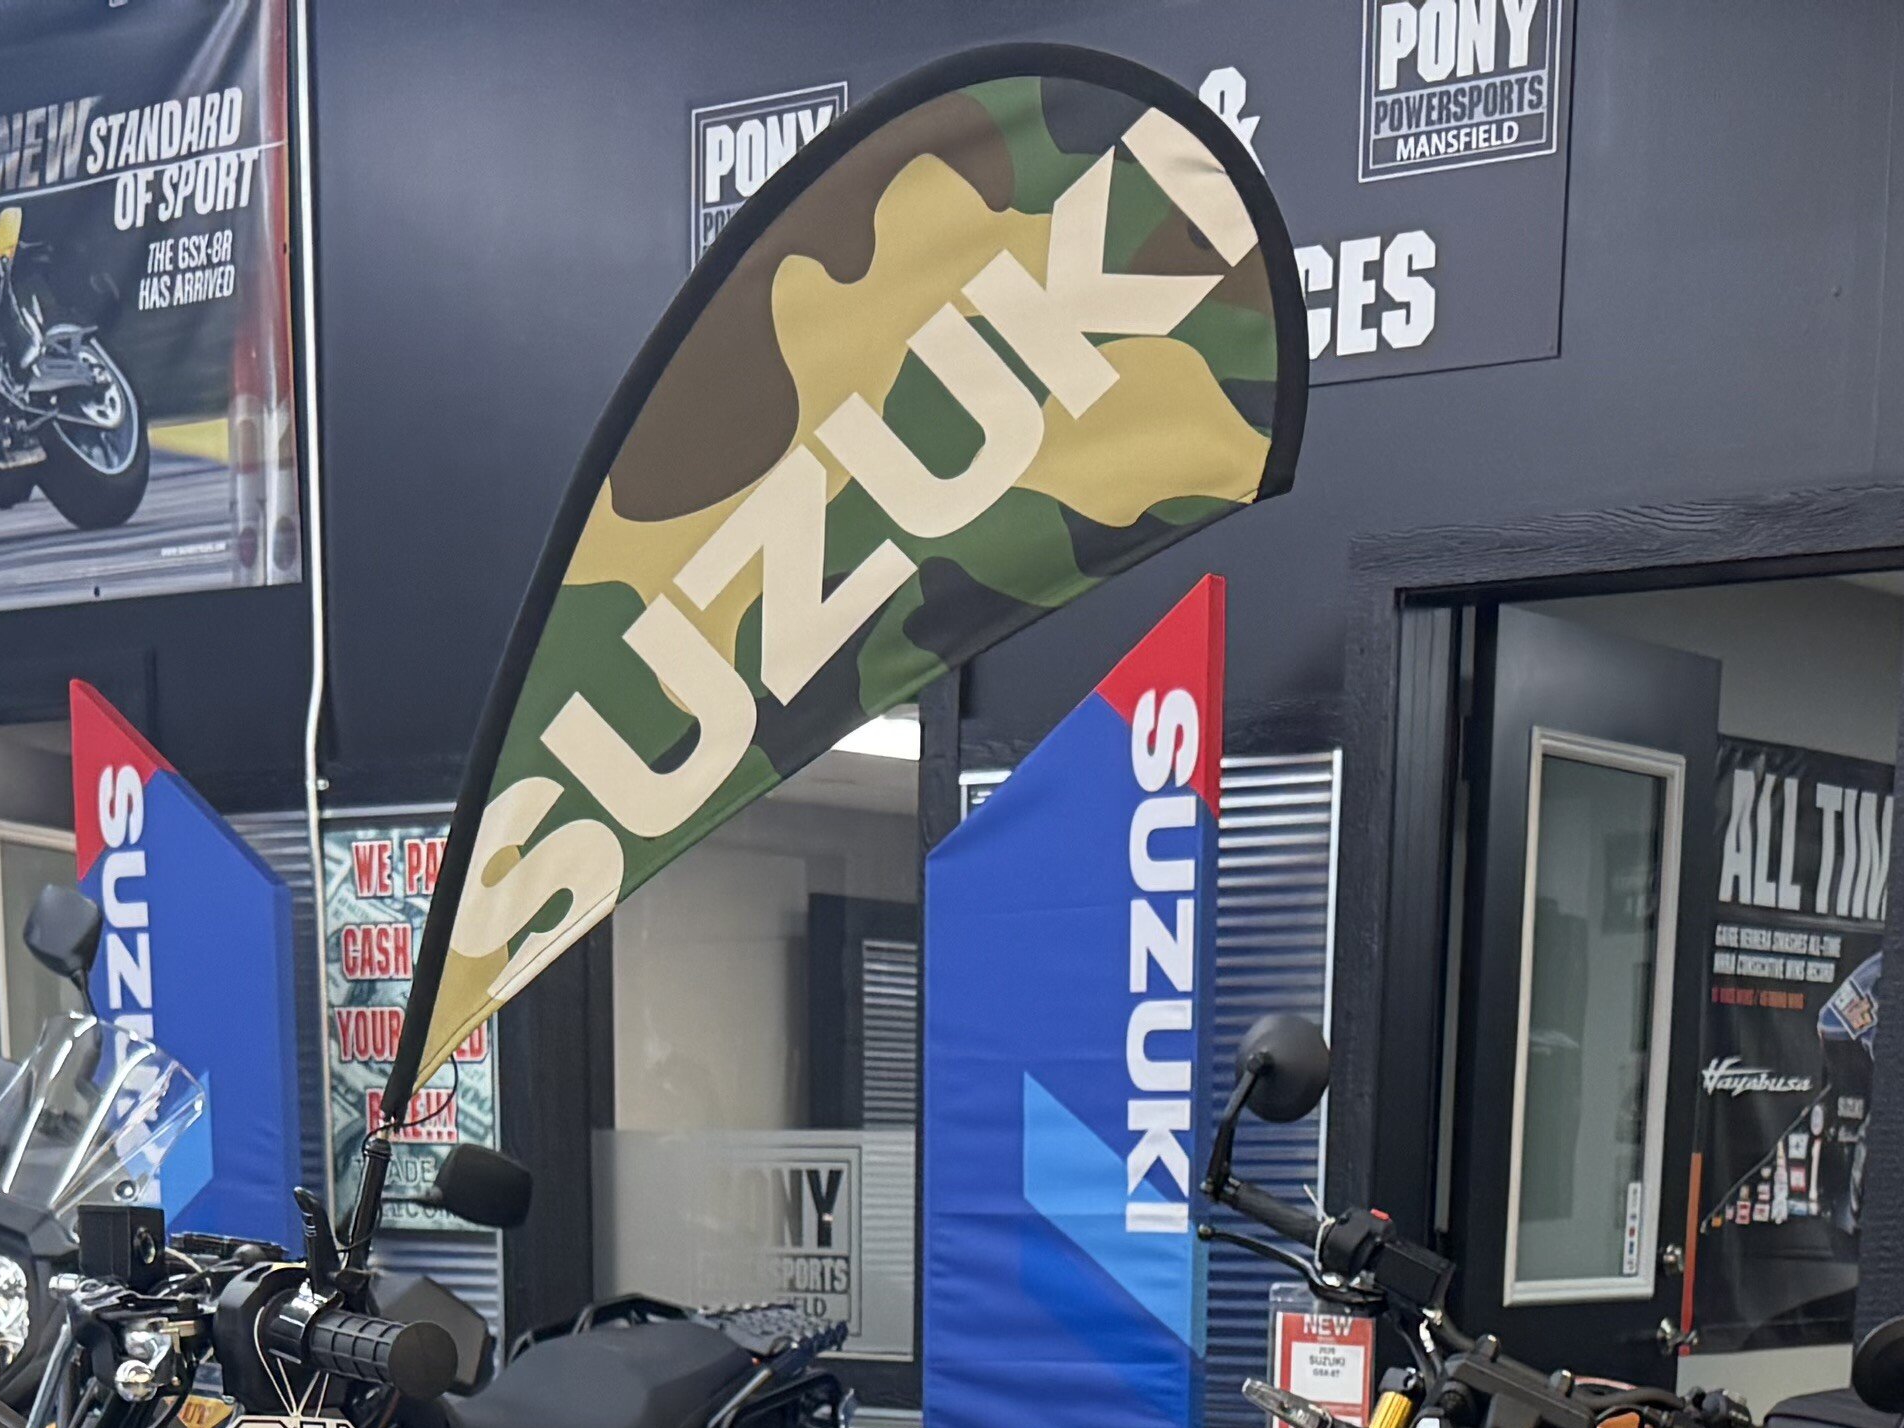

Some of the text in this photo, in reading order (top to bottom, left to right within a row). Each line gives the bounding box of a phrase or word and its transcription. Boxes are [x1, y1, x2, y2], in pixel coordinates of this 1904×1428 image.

[1379, 0, 1540, 90] PONY
[86, 87, 243, 174] STANDARD
[1373, 73, 1545, 133] POWERSPORTS
[703, 107, 834, 203] PONY
[1394, 121, 1520, 162] MANSFIELD
[114, 149, 262, 231] OF SPORT
[148, 230, 233, 273] THE GSX-8R
[139, 266, 235, 310] HAS ARRIVED
[450, 107, 1259, 957] SUZUKI
[351, 839, 394, 897] WE
[1718, 769, 1801, 912] ALL
[341, 922, 413, 981] CASH
[1126, 687, 1200, 1233] SUZUKI
[1702, 1056, 1811, 1097] Hayabusa
[1303, 1314, 1354, 1336] NEW
[1309, 1355, 1346, 1367] SUZUKI
